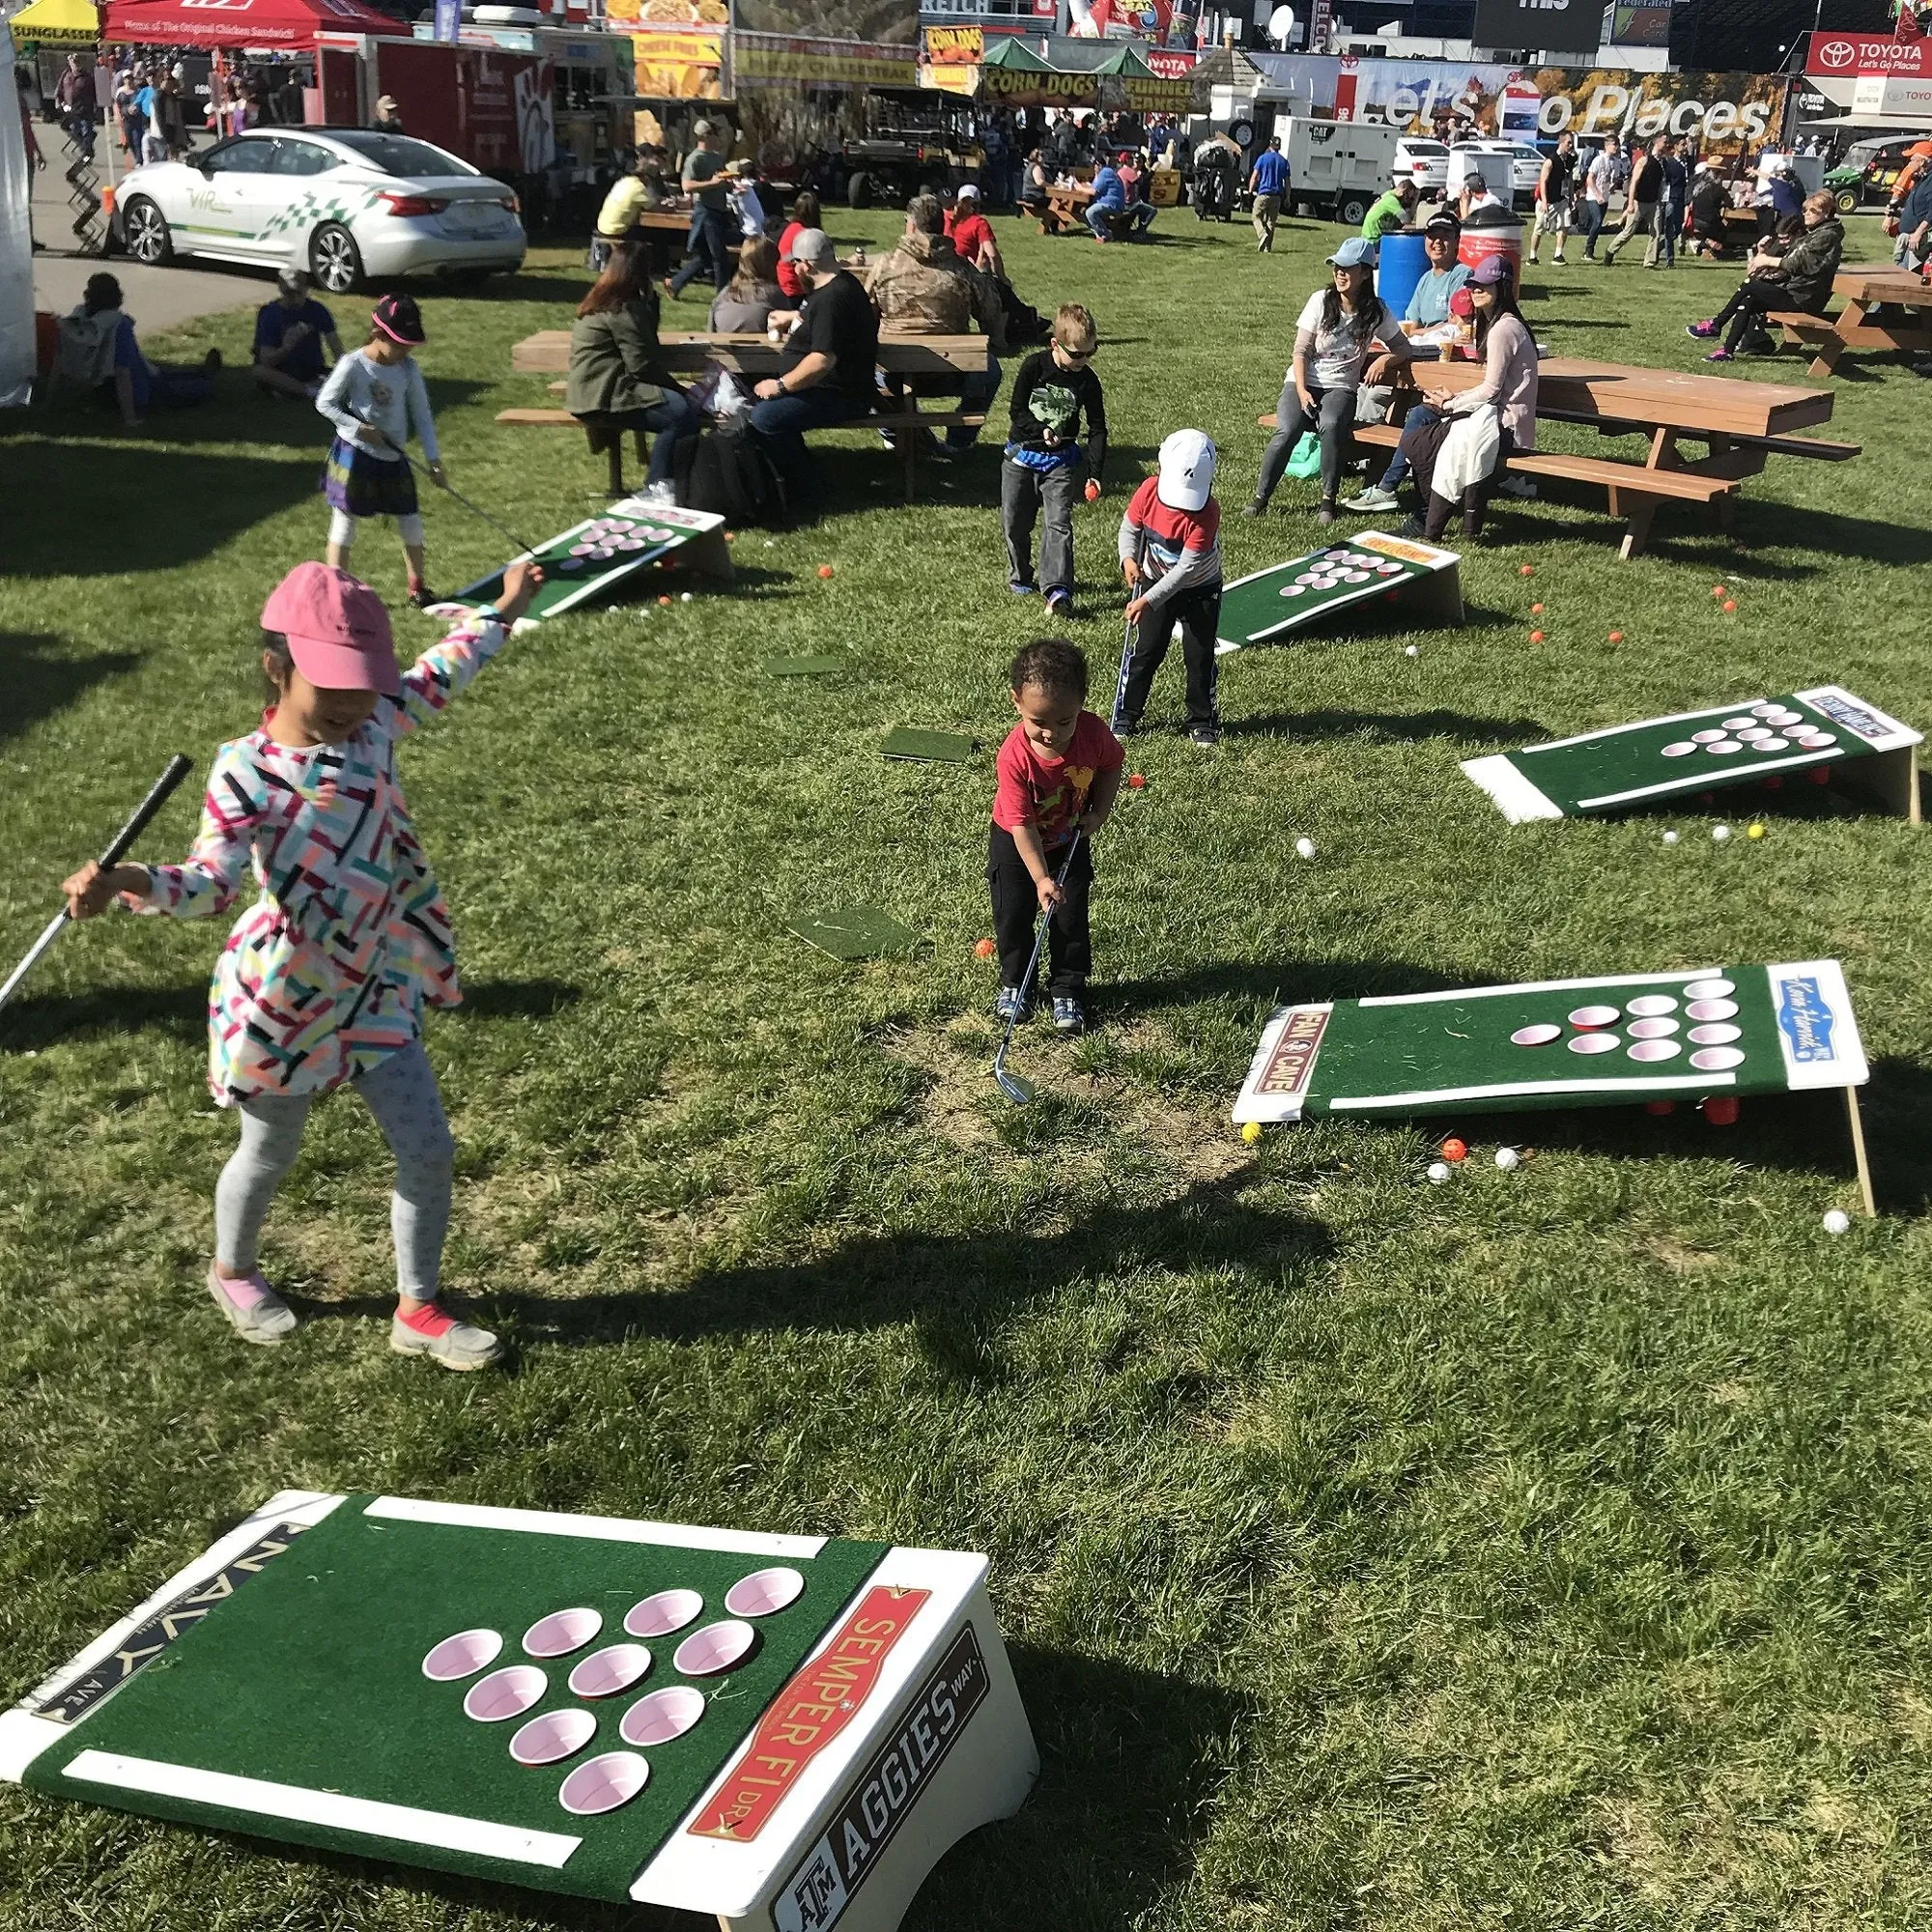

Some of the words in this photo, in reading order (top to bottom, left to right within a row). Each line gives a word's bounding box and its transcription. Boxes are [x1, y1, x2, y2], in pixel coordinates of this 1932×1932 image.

[1858, 59, 1878, 69] Let's
[1879, 60, 1891, 70] Go
[1892, 60, 1920, 70] Places
[1859, 43, 1922, 60] TOYOTA
[986, 71, 1040, 94] CORN
[1046, 74, 1096, 96] DOGS
[1123, 78, 1192, 96] FUNNEL
[1130, 98, 1188, 112] CAKES
[1583, 84, 1770, 142] Places
[1313, 127, 1328, 137] CAT
[1289, 1014, 1324, 1038] FAN
[1264, 1056, 1305, 1091] CAVE
[115, 1540, 290, 1678] NAVY
[64, 1678, 103, 1707] AVE
[769, 1617, 896, 1747] SEMPER
[740, 1755, 798, 1787] FI
[842, 1680, 956, 1880] AGGIES
[728, 1791, 763, 1819] DR
